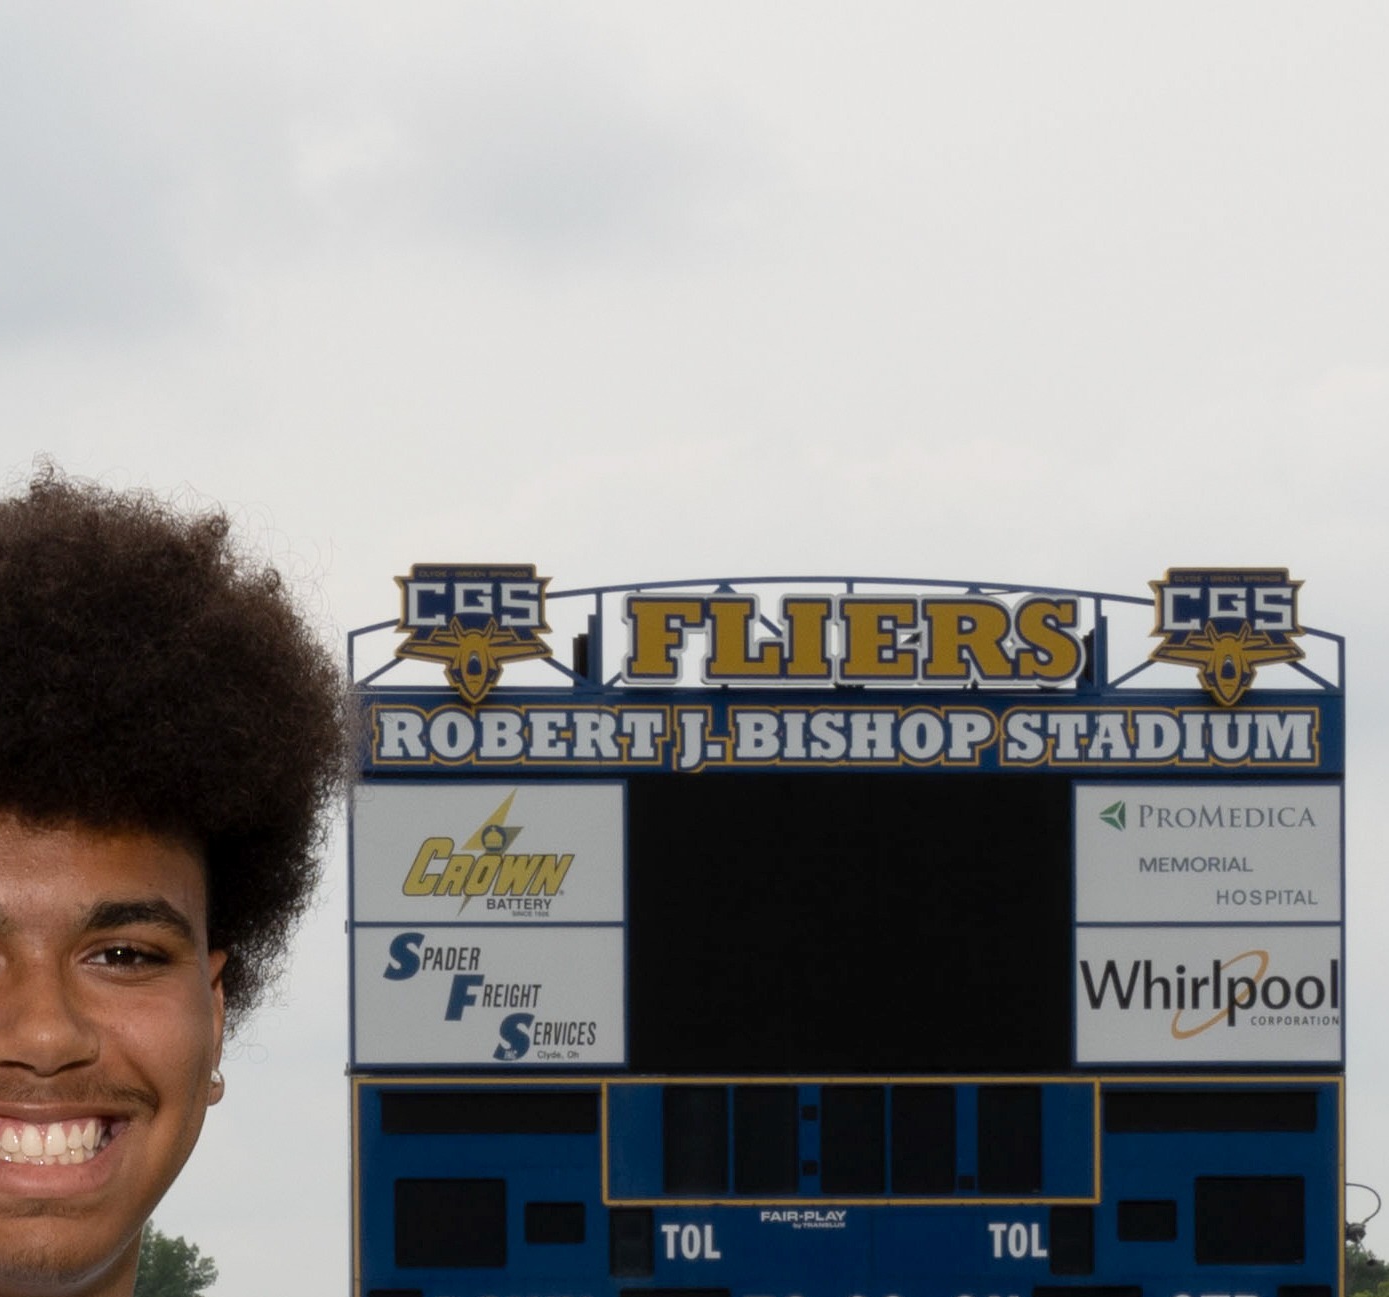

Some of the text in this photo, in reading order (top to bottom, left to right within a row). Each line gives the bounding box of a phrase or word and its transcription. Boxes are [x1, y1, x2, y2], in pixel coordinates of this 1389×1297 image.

[407, 582, 540, 626] CGS
[1163, 587, 1294, 631] CGS
[623, 593, 1083, 685] FLIERS
[379, 711, 1313, 768] ROBERT J. BISHOP STADIUM
[402, 836, 576, 897] CROWN
[1138, 856, 1254, 873] MEMORIAL
[486, 898, 552, 910] BATTERY
[1216, 889, 1319, 906] HOSPITAL
[382, 932, 482, 982] SPADER
[444, 974, 542, 1021] FREIGHT
[1079, 958, 1339, 1027] Whirlpool
[492, 1012, 597, 1061] SERVICES
[1250, 1015, 1340, 1026] CORPORATION
[760, 1211, 847, 1222] FAIR-PLAY
[661, 1224, 721, 1260] TOL
[988, 1223, 1048, 1259] TOL
